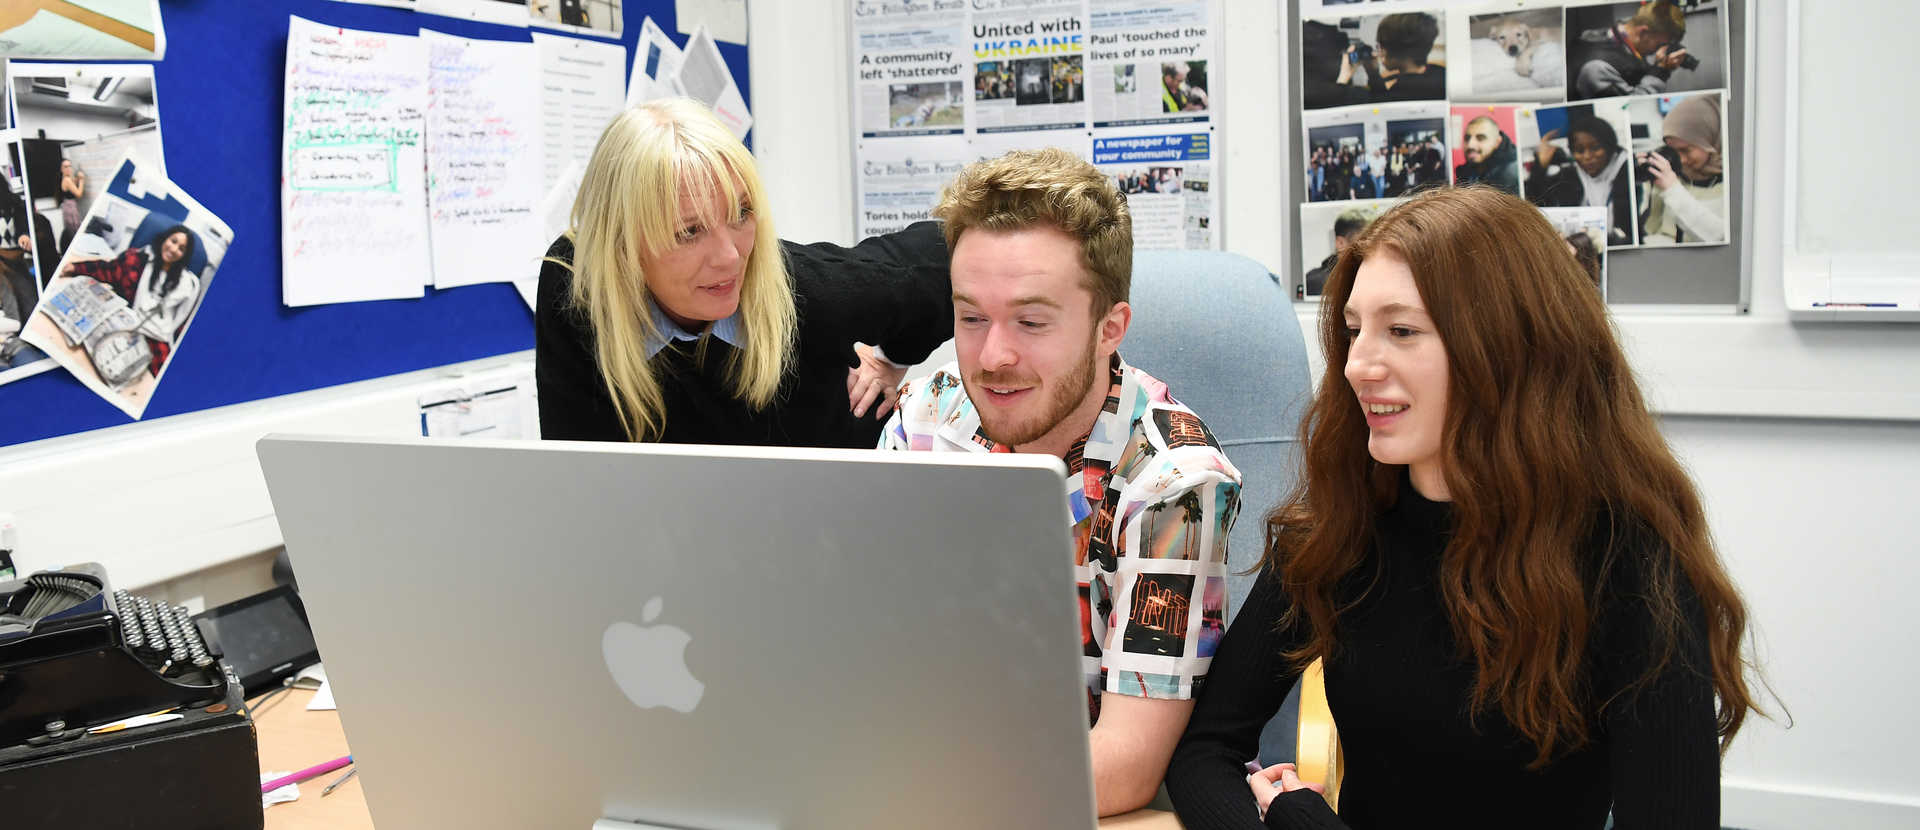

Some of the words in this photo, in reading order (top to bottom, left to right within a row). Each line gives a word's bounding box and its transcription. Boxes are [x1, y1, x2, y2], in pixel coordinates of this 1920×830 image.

[973, 20, 1034, 38] United
[1041, 16, 1081, 33] with
[1090, 34, 1118, 45] Paul
[1184, 27, 1207, 38] the
[973, 34, 1084, 59] UKRAINE
[1090, 51, 1119, 60] lives
[1123, 48, 1136, 58] of
[1141, 48, 1155, 57] so
[860, 54, 870, 65] A
[874, 50, 953, 64] community
[860, 69, 883, 79] left
[1095, 140, 1105, 149] A
[1106, 137, 1164, 150] newspaper
[1165, 135, 1183, 146] for
[1095, 153, 1120, 163] your
[1121, 148, 1183, 160] community
[865, 212, 898, 221] Tories
[902, 210, 928, 220] hold
[865, 226, 905, 235] council
